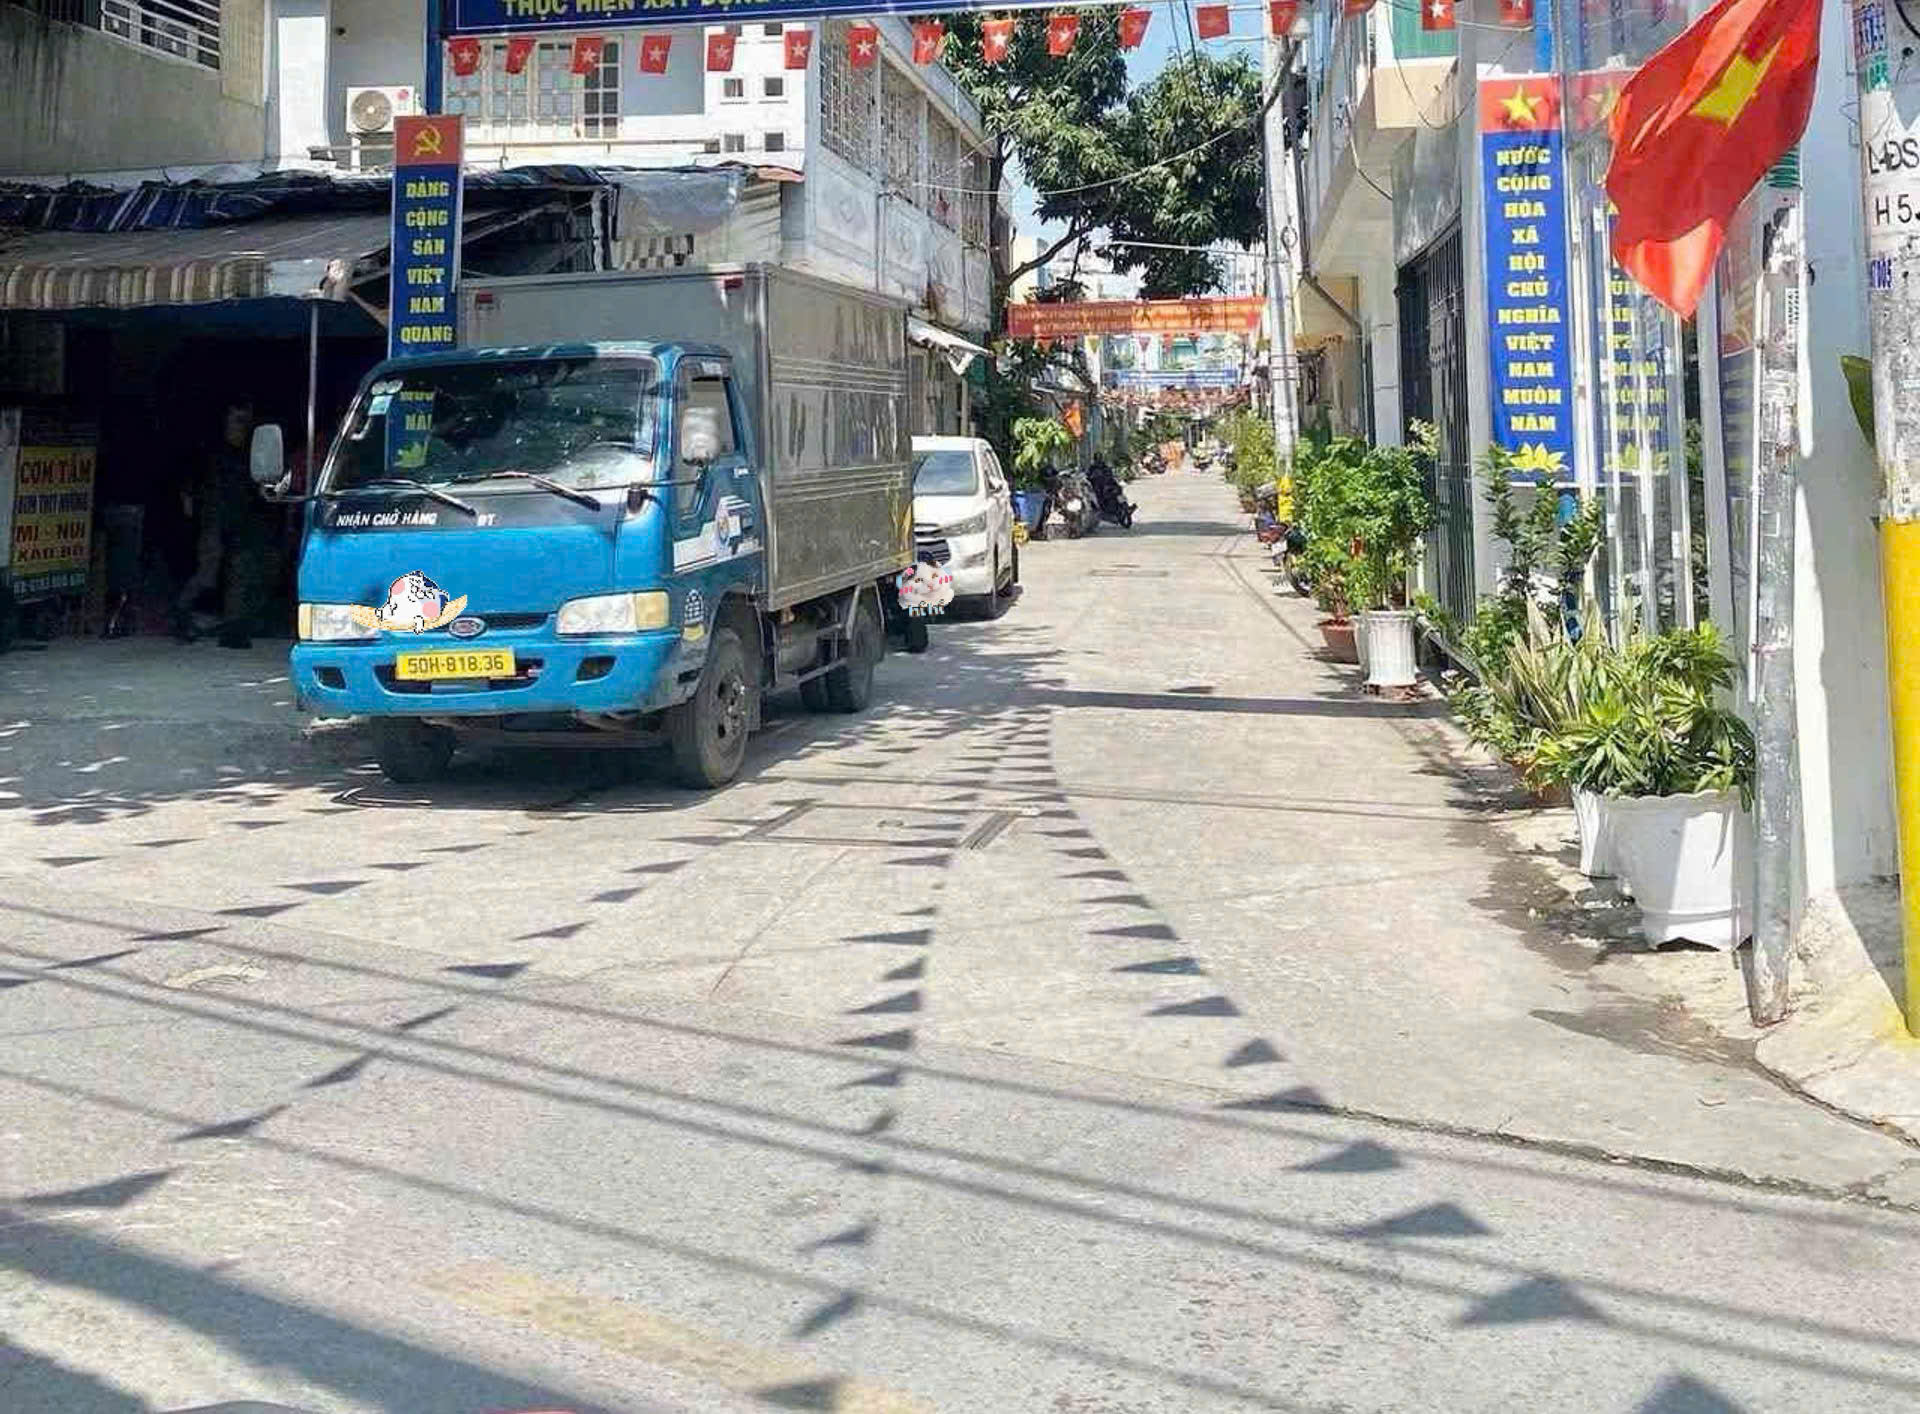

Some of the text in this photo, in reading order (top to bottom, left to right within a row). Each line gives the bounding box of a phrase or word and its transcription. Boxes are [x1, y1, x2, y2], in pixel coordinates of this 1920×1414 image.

[405, 206, 449, 231] CỘNG
[409, 297, 445, 315] NAM
[400, 326, 454, 344] QUANG
[1505, 331, 1555, 354] VIỆT
[1508, 362, 1554, 378] NAM
[1503, 384, 1562, 404] MUÔN
[336, 512, 371, 528] NHẬN
[401, 510, 438, 526] HÀNG
